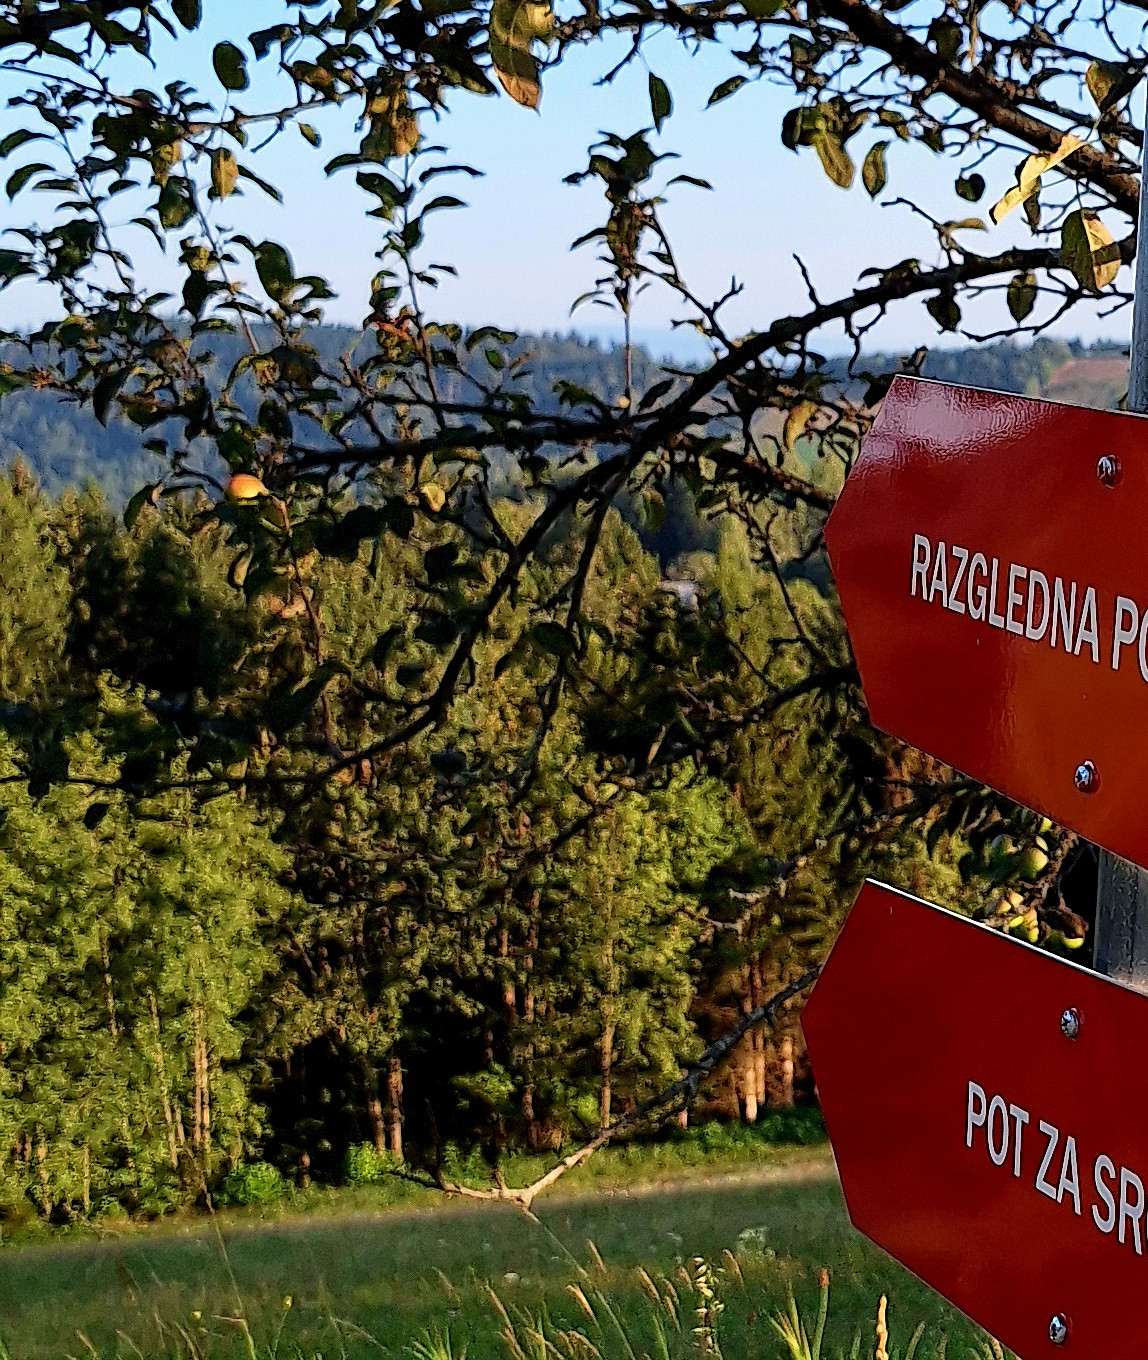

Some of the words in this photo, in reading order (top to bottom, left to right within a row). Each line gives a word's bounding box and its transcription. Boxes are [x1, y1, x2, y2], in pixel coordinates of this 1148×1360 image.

[910, 533, 1100, 663] RAZGLEDNA
[966, 1080, 1030, 1178] POT
[1035, 1119, 1082, 1216] ZA
